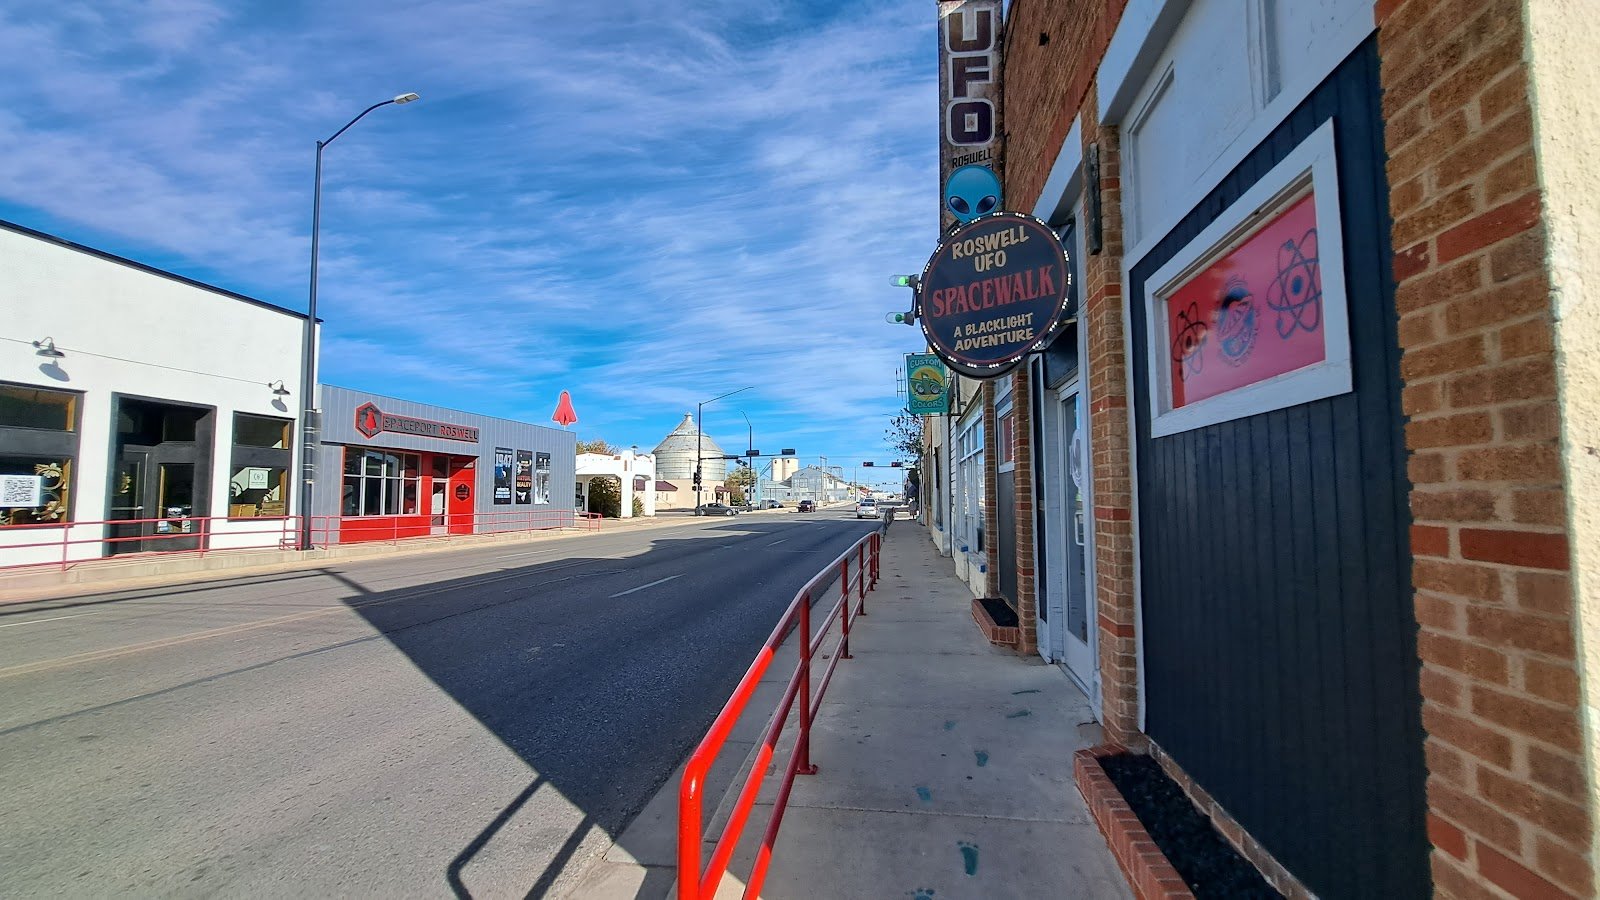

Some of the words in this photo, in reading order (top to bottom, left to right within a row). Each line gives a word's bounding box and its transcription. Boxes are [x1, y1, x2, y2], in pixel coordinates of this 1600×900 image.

[945, 6, 995, 147] UFO
[952, 148, 993, 169] ROSWELL
[952, 225, 1030, 260] ROSWELL
[974, 250, 1007, 273] UFO
[932, 264, 1056, 318] SPACEWALK
[953, 326, 962, 338] A
[965, 312, 1034, 336] BLACKLIGHT
[954, 327, 1035, 352] ADVENTURE
[910, 358, 941, 369] CUSTOM
[912, 397, 944, 408] COLORS
[384, 417, 437, 433] SPACEPORT
[440, 425, 478, 439] ROSWELL
